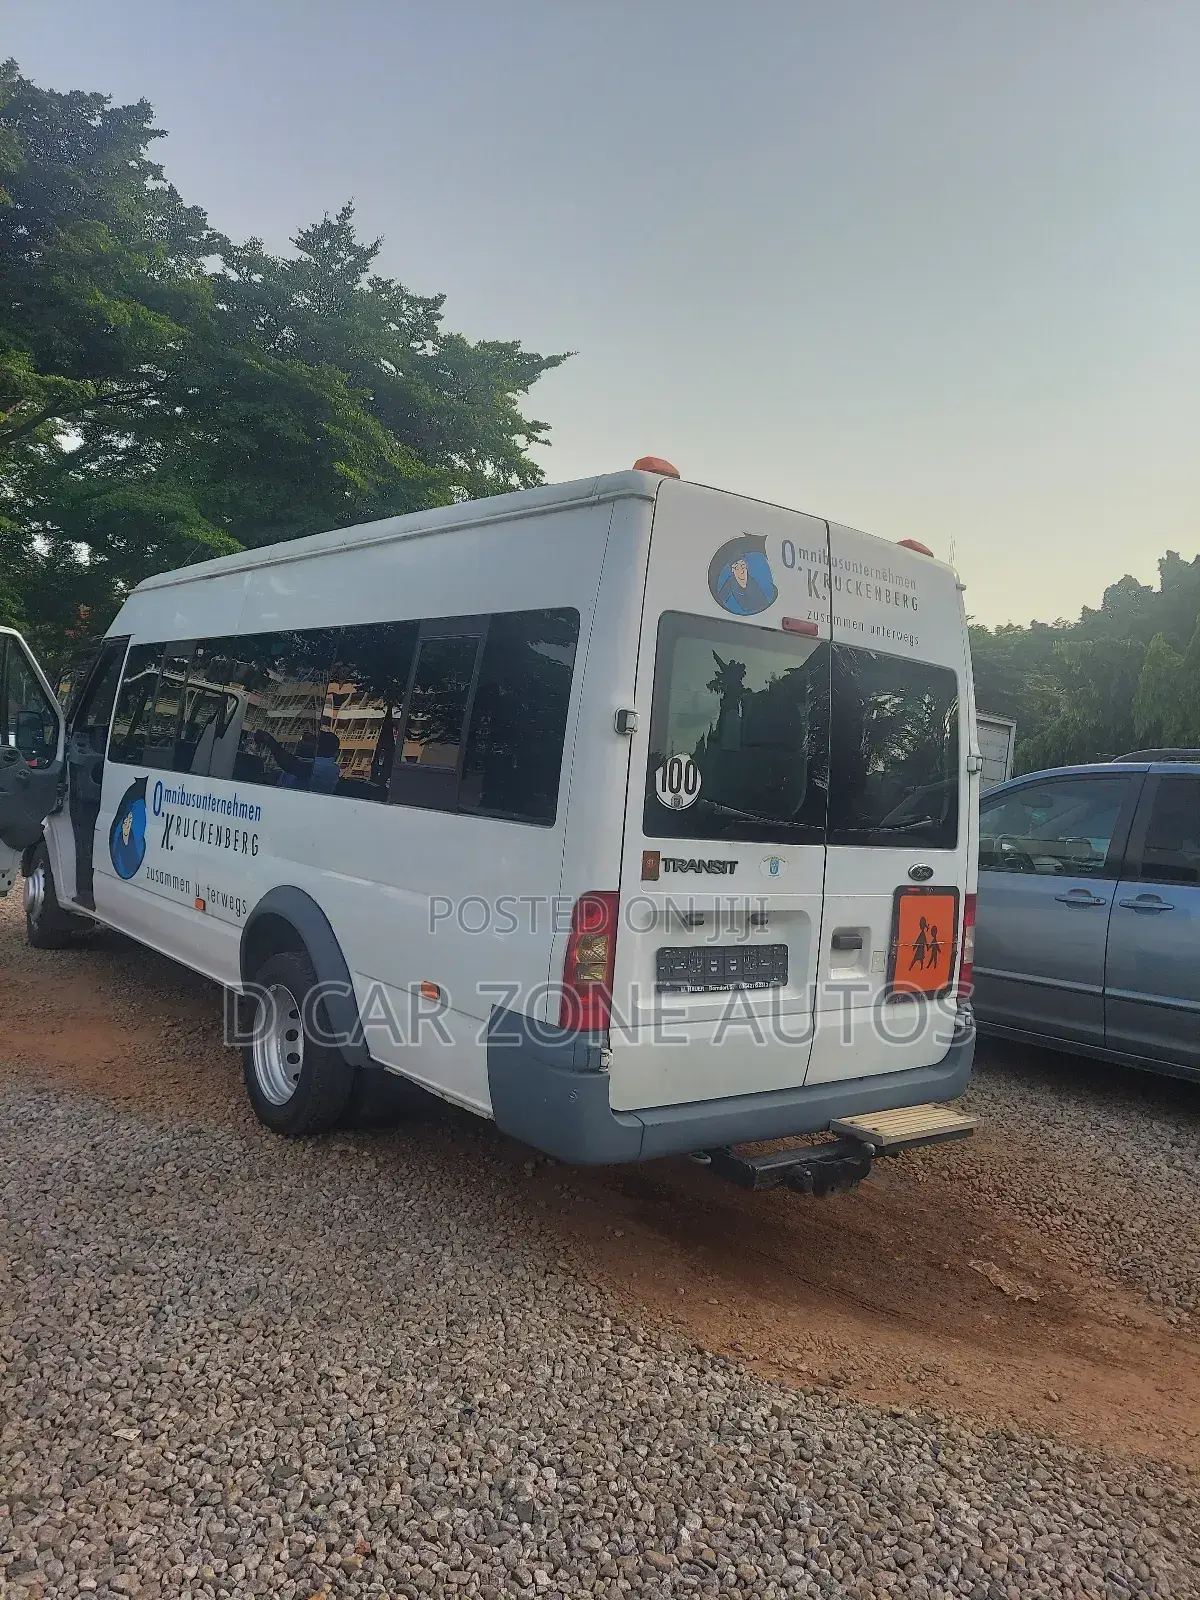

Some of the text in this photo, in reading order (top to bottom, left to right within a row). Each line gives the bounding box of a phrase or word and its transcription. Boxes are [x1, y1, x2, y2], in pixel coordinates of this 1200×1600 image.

[806, 609, 920, 647] zusammen unterwegs
[661, 757, 698, 796] 100
[661, 857, 739, 875] TRANSIT
[146, 866, 248, 918] zusammen uterwegs
